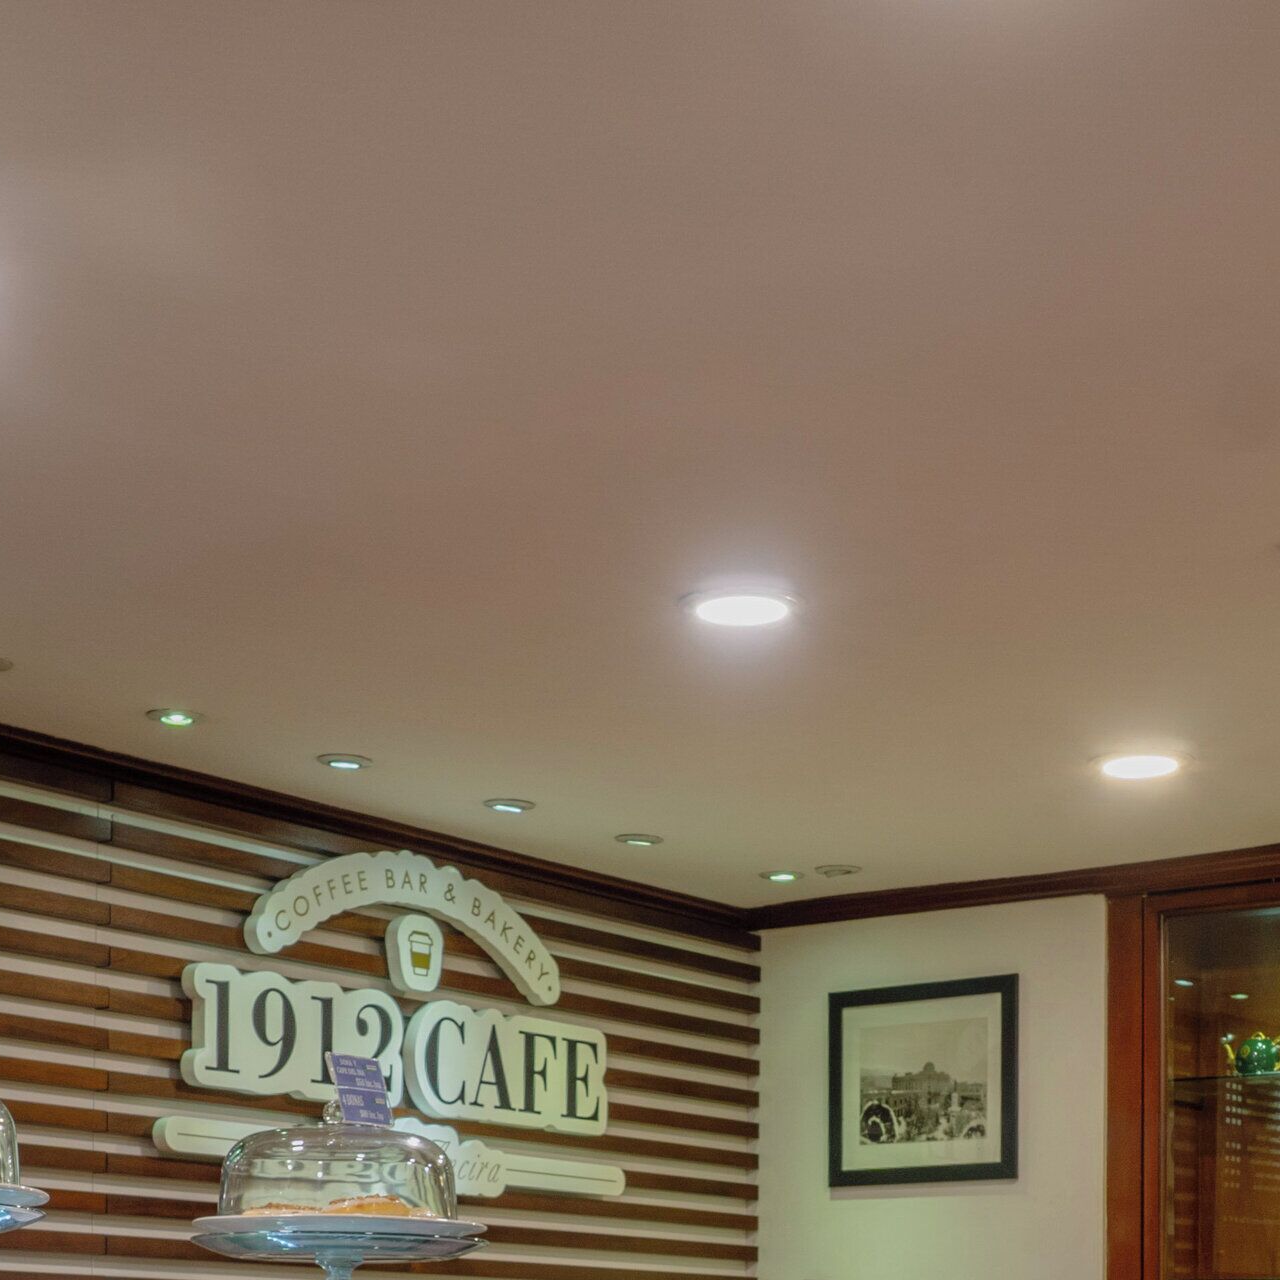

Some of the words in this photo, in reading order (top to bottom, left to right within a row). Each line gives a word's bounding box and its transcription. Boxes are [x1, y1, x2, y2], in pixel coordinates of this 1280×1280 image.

[275, 869, 369, 931] COFFEE
[385, 868, 428, 894] BAR
[443, 883, 456, 904] &
[470, 897, 550, 982] BAKERY
[204, 978, 393, 1091] 1912
[424, 1014, 601, 1123] CAFE
